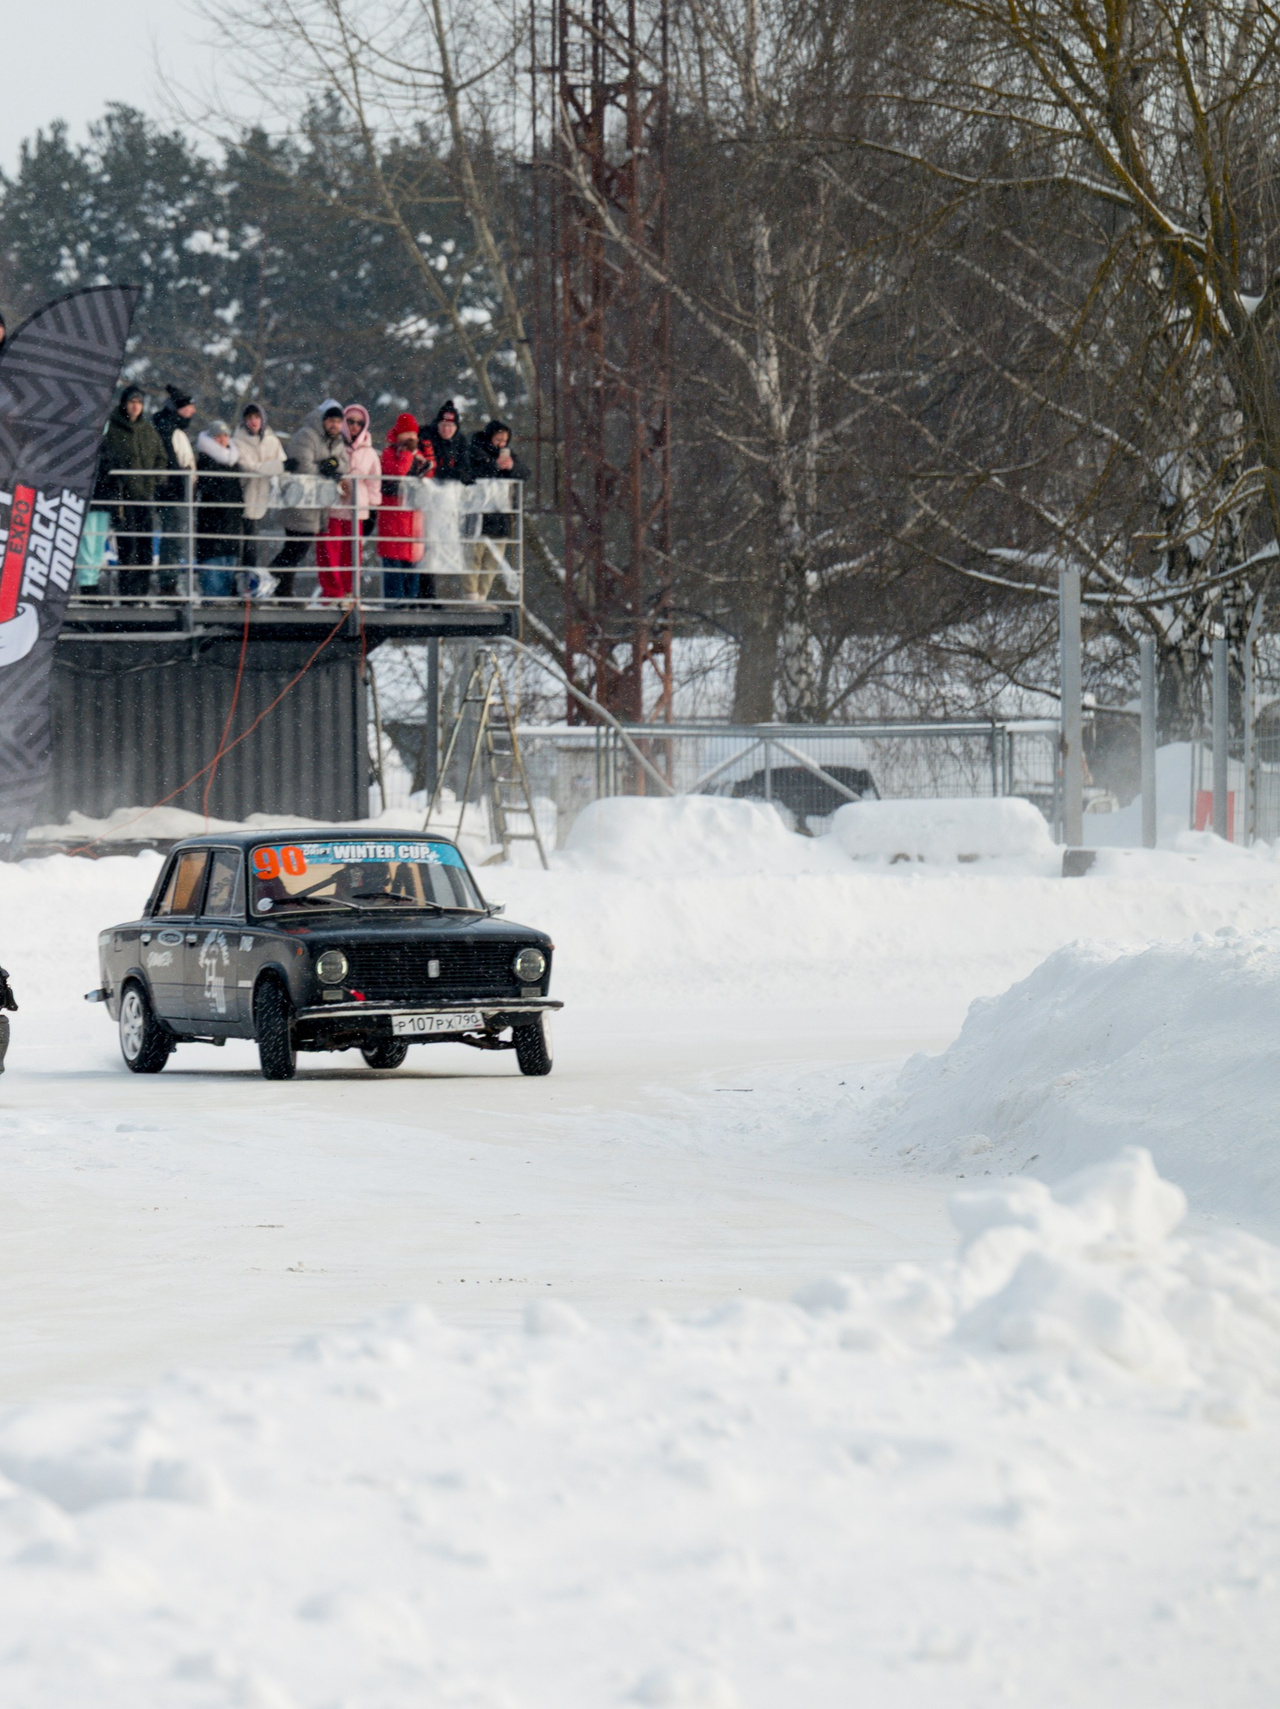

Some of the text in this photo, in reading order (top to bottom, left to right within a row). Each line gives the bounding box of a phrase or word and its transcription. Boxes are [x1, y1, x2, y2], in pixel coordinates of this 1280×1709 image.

[9, 500, 31, 555] EXPO
[21, 491, 61, 601] TRACK
[49, 488, 86, 592] MODE
[253, 846, 307, 880] 90
[333, 844, 431, 860] WINTER CUP
